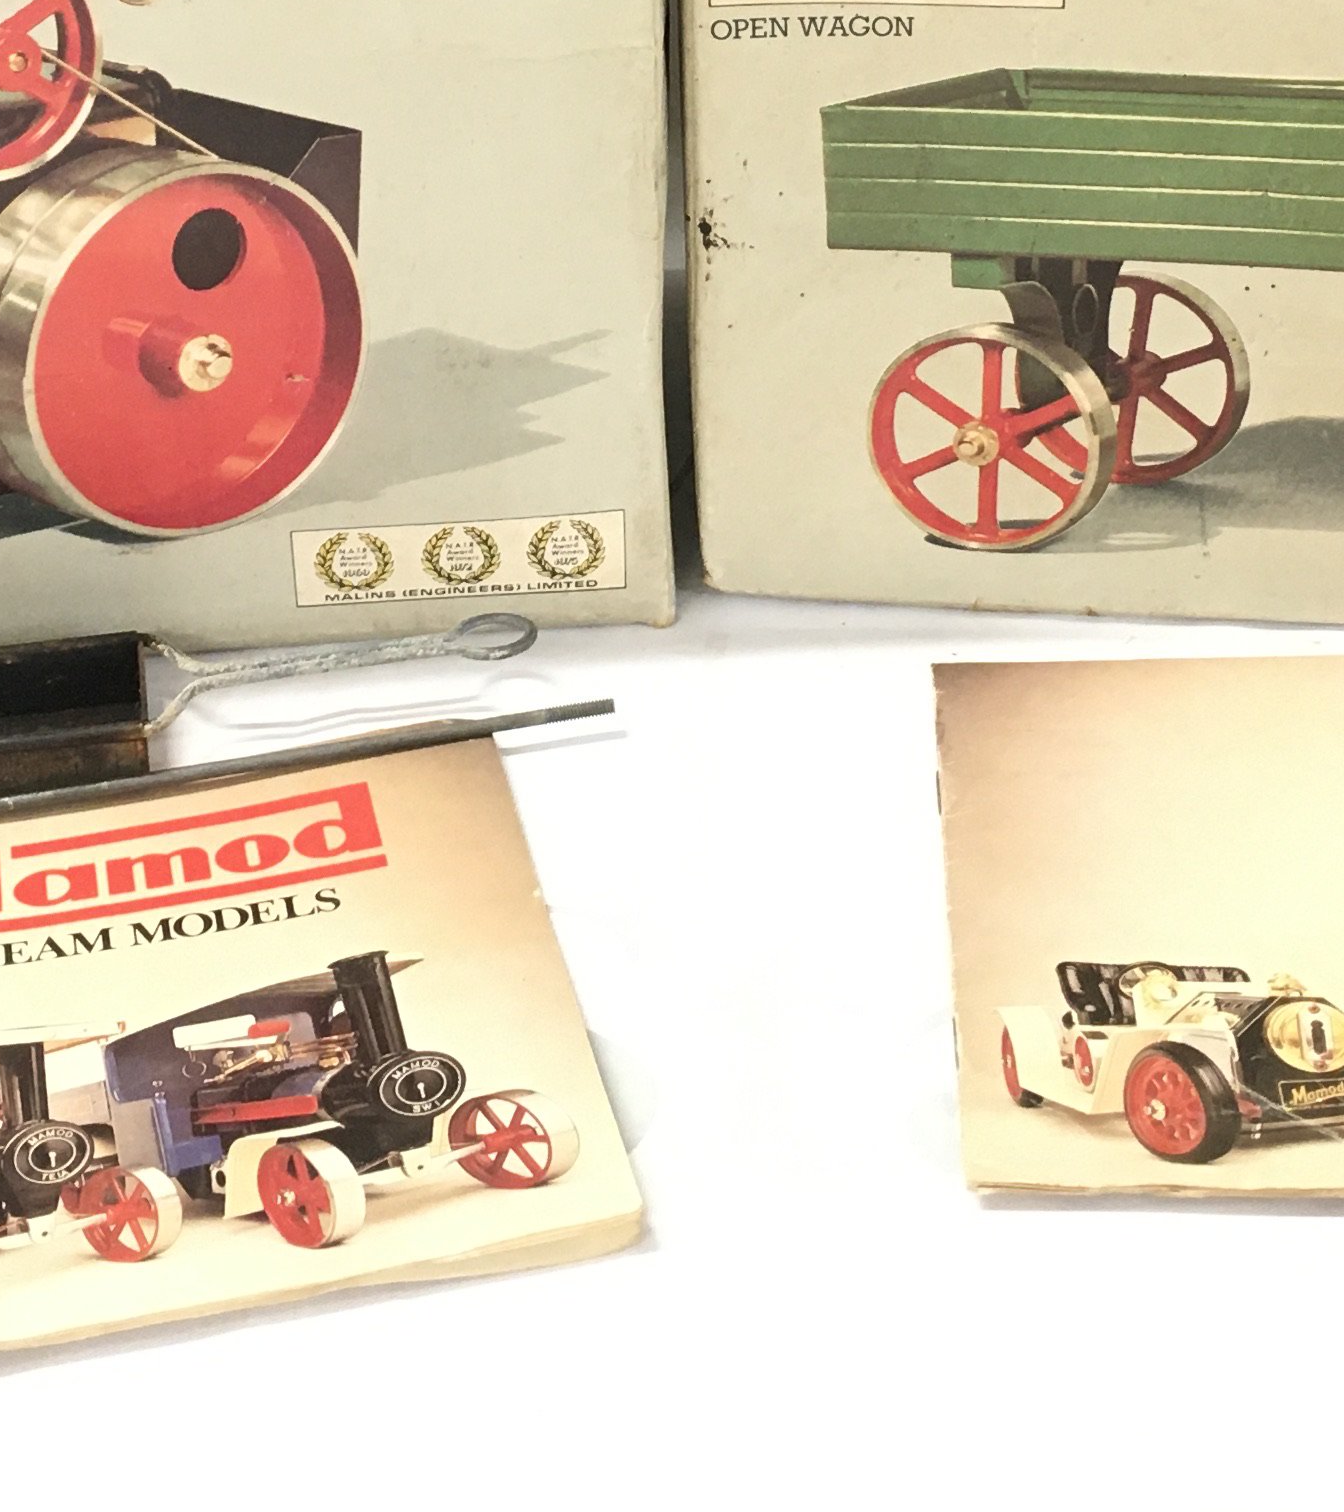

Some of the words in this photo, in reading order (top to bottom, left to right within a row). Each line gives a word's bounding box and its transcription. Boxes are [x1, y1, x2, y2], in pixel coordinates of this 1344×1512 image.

[709, 16, 790, 40] OPEN
[798, 13, 915, 38] WAGON
[324, 591, 396, 602] MALINS
[402, 584, 522, 598] (ENGINEERS)
[526, 579, 599, 590] LIMITED
[129, 887, 343, 948] MODELS
[391, 1058, 440, 1080] MAMOD
[27, 1128, 74, 1146] MAMOD
